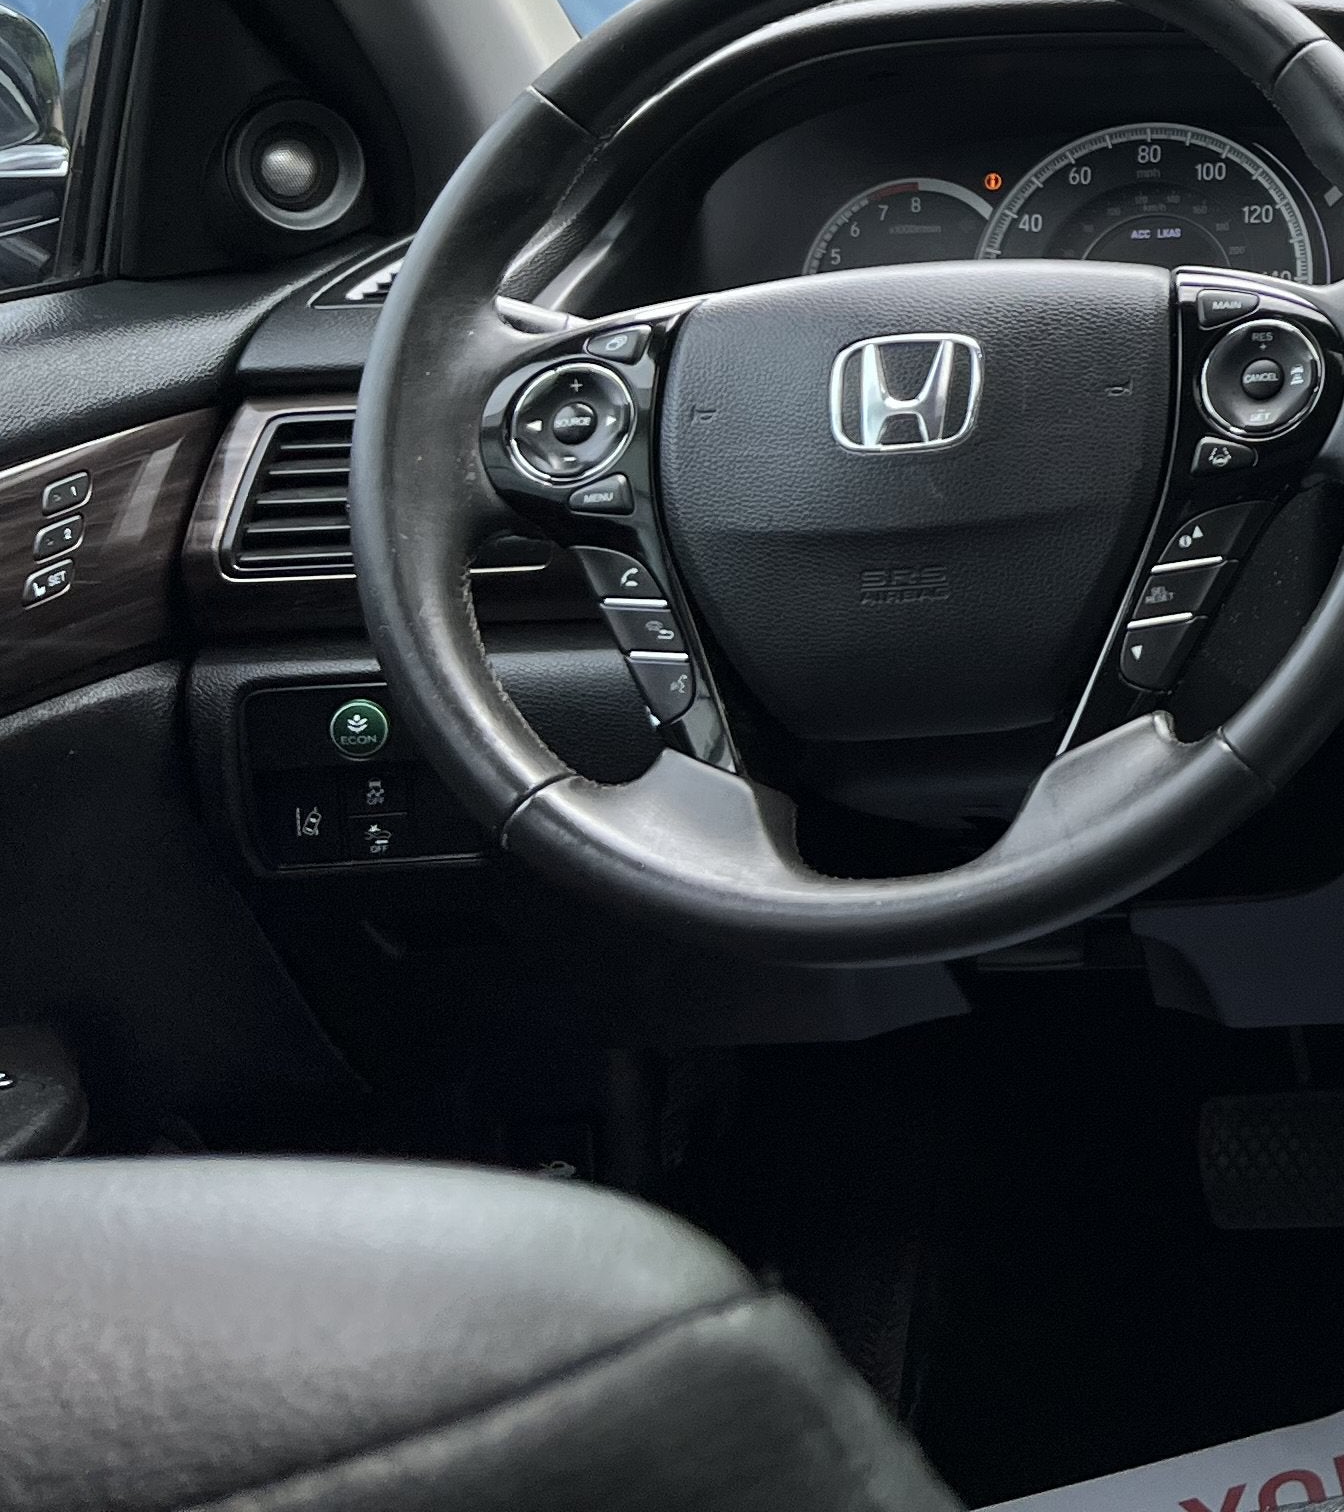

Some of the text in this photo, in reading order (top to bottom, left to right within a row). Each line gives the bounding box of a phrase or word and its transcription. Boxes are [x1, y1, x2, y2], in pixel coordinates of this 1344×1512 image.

[1137, 144, 1162, 164] 80
[1068, 166, 1092, 185] 60
[1194, 162, 1227, 181] 100
[877, 204, 889, 222] 7
[910, 196, 922, 213] 8
[1241, 204, 1274, 224] 120
[850, 221, 861, 238] 6
[1018, 213, 1043, 233] 40
[1130, 229, 1151, 240] ACC
[830, 248, 841, 265] 5
[1212, 300, 1242, 310] MAIN
[1251, 331, 1274, 342] RES
[1242, 372, 1279, 384] CANCEL
[554, 416, 592, 428] SOURCE
[1250, 412, 1271, 422] SET
[583, 491, 614, 504] MENU
[47, 570, 66, 587] SET
[339, 734, 377, 746] ECON
[366, 796, 385, 805] OFF
